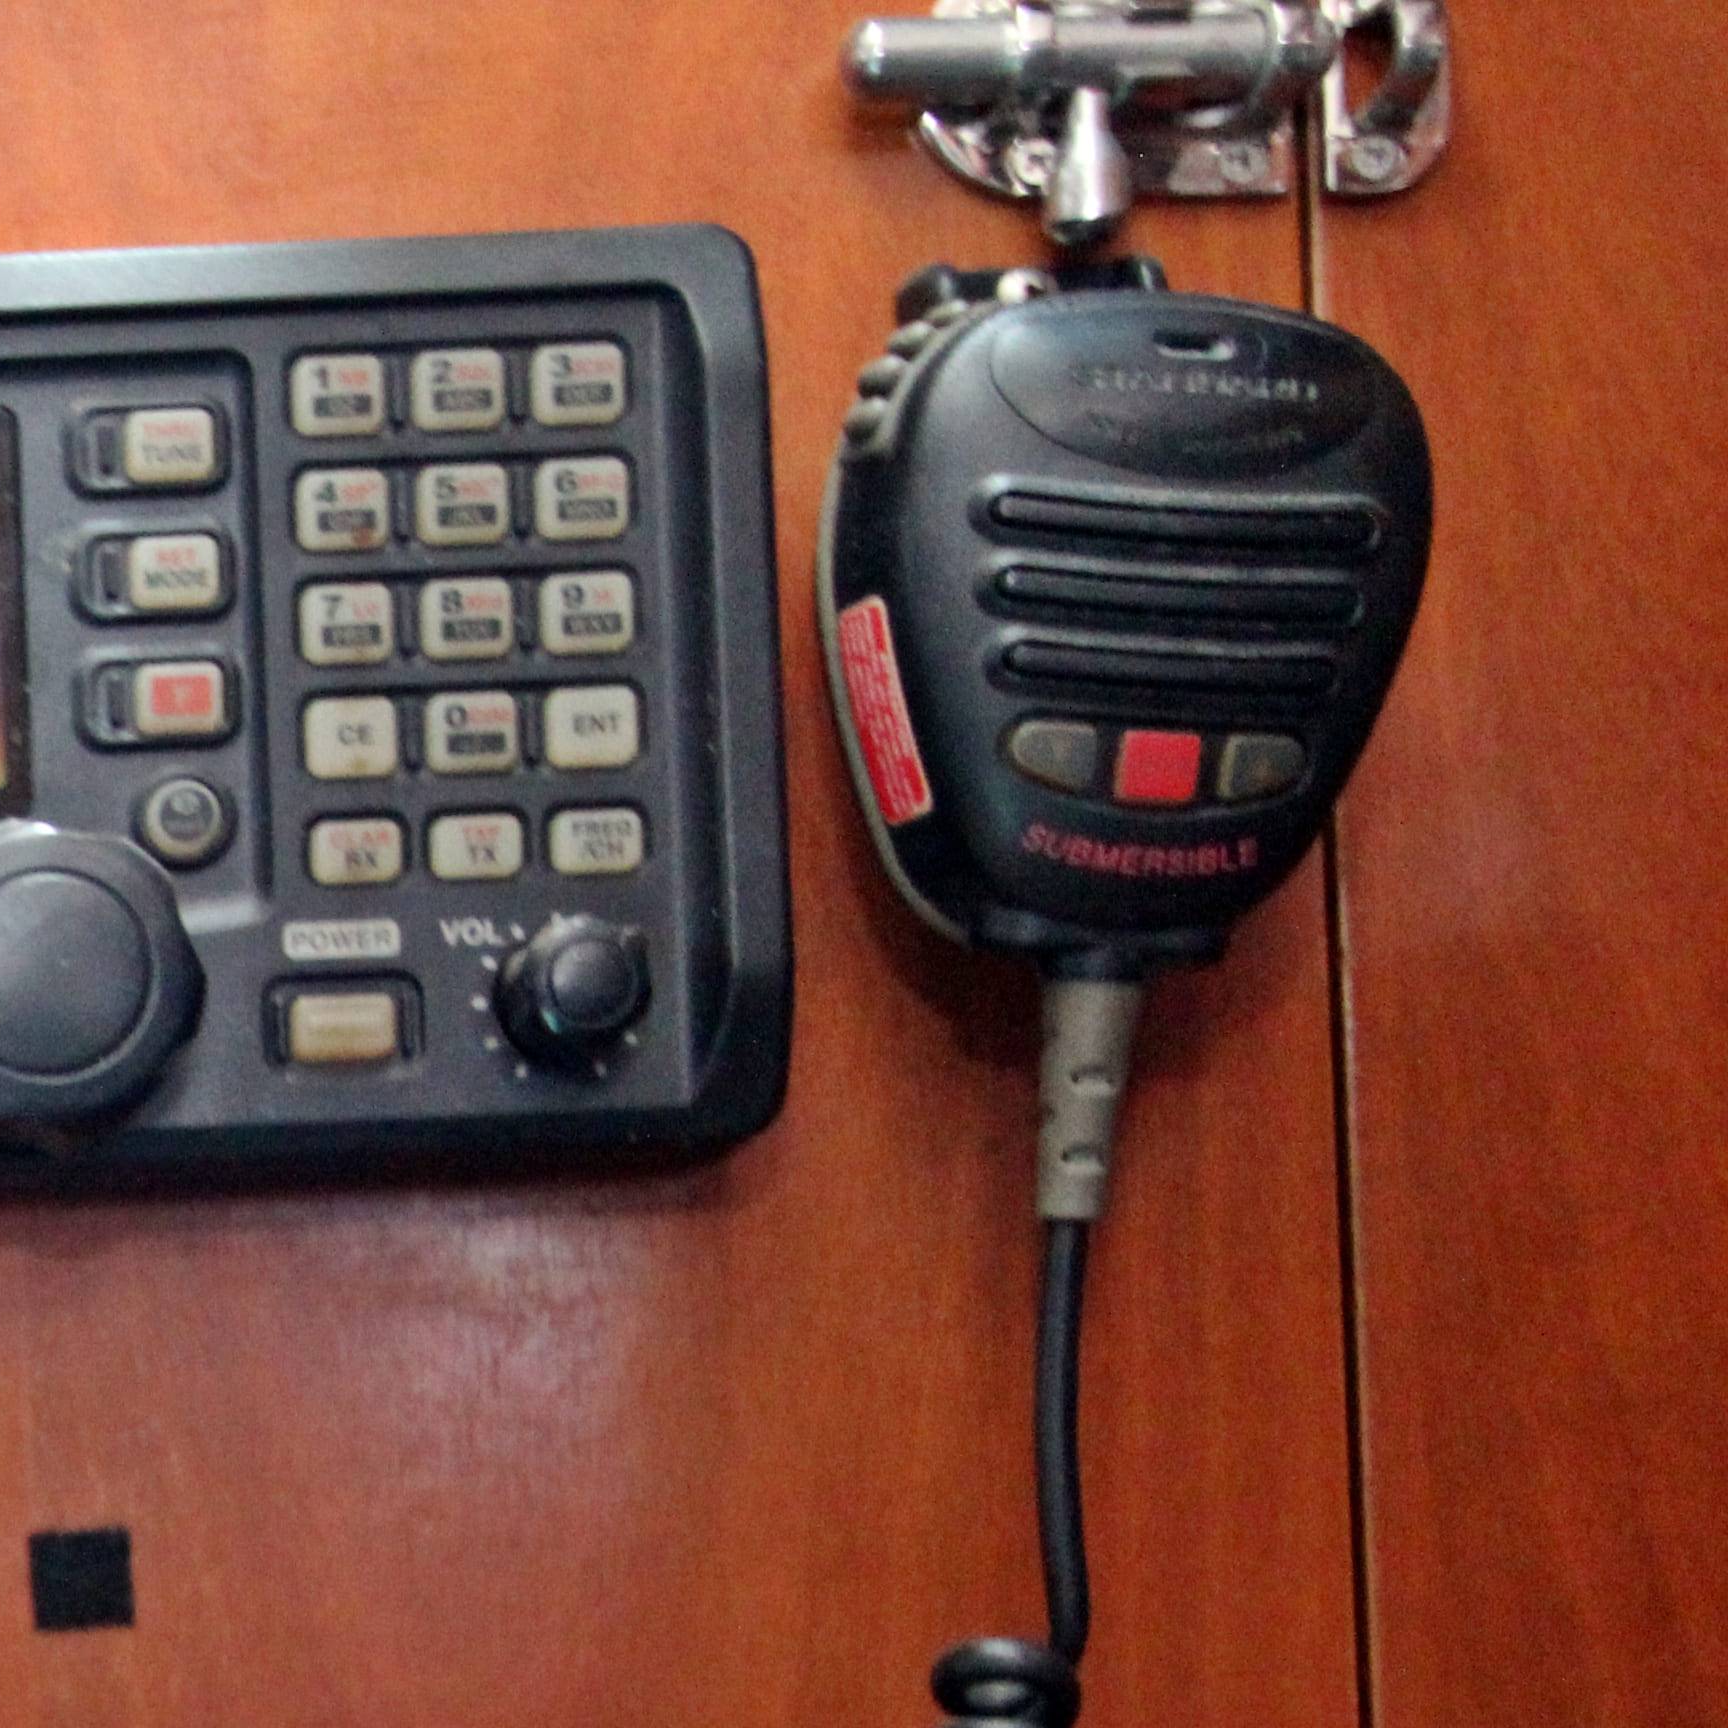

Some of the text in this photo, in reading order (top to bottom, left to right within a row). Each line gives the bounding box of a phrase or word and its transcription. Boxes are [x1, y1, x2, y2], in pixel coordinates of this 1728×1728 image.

[431, 360, 453, 383] 2
[551, 354, 572, 377] 3
[435, 475, 456, 499] 5
[555, 470, 577, 494] 6
[320, 595, 342, 618] 7
[441, 589, 463, 613] 8
[562, 584, 584, 608] 9
[338, 723, 374, 745] CE
[573, 713, 621, 735] ENT
[468, 845, 498, 865] TX
[1020, 821, 1260, 877] SUBMERSIBLE
[291, 928, 393, 952] POWER
[439, 917, 506, 947] VOL
